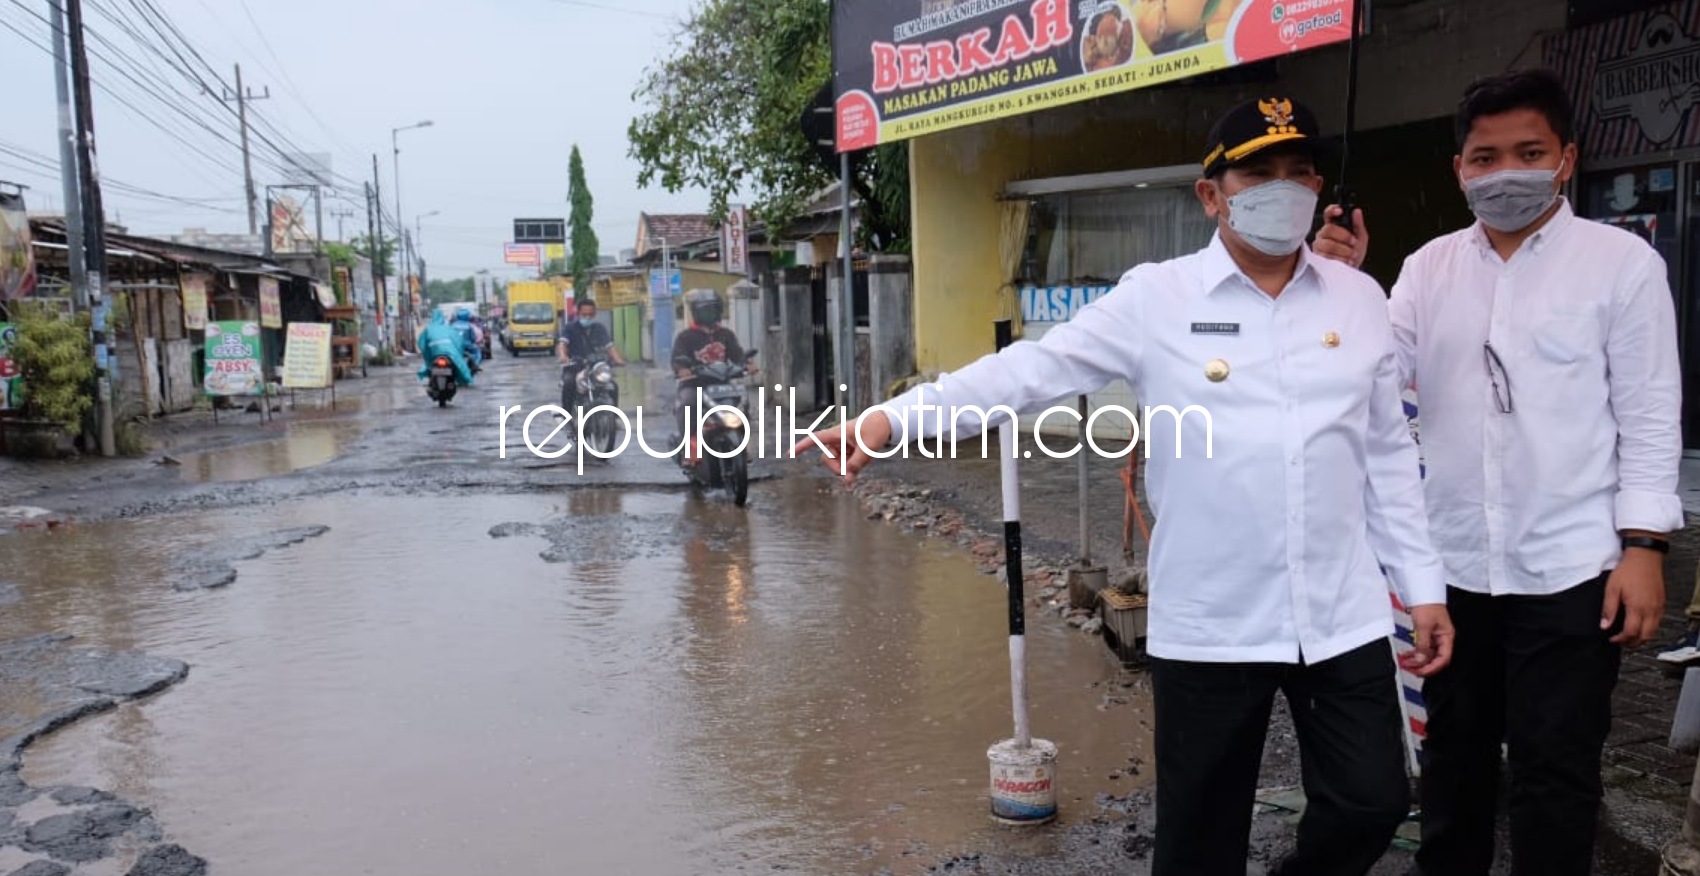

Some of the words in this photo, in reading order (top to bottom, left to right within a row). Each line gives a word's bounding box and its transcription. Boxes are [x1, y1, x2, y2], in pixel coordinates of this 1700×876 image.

[1297, 9, 1342, 36] gofood
[871, 0, 1073, 93] BERKAH
[884, 83, 947, 115] MASAKAN
[950, 67, 1010, 99] PADANG
[1013, 57, 1058, 83] JAWA
[895, 124, 907, 134] JL.
[909, 119, 931, 131] RAYA
[998, 99, 1015, 111] NO.
[1095, 71, 1137, 89] SEDATI
[1149, 55, 1200, 78] JUANDA
[223, 333, 241, 345] ES
[215, 360, 250, 373] ABSY
